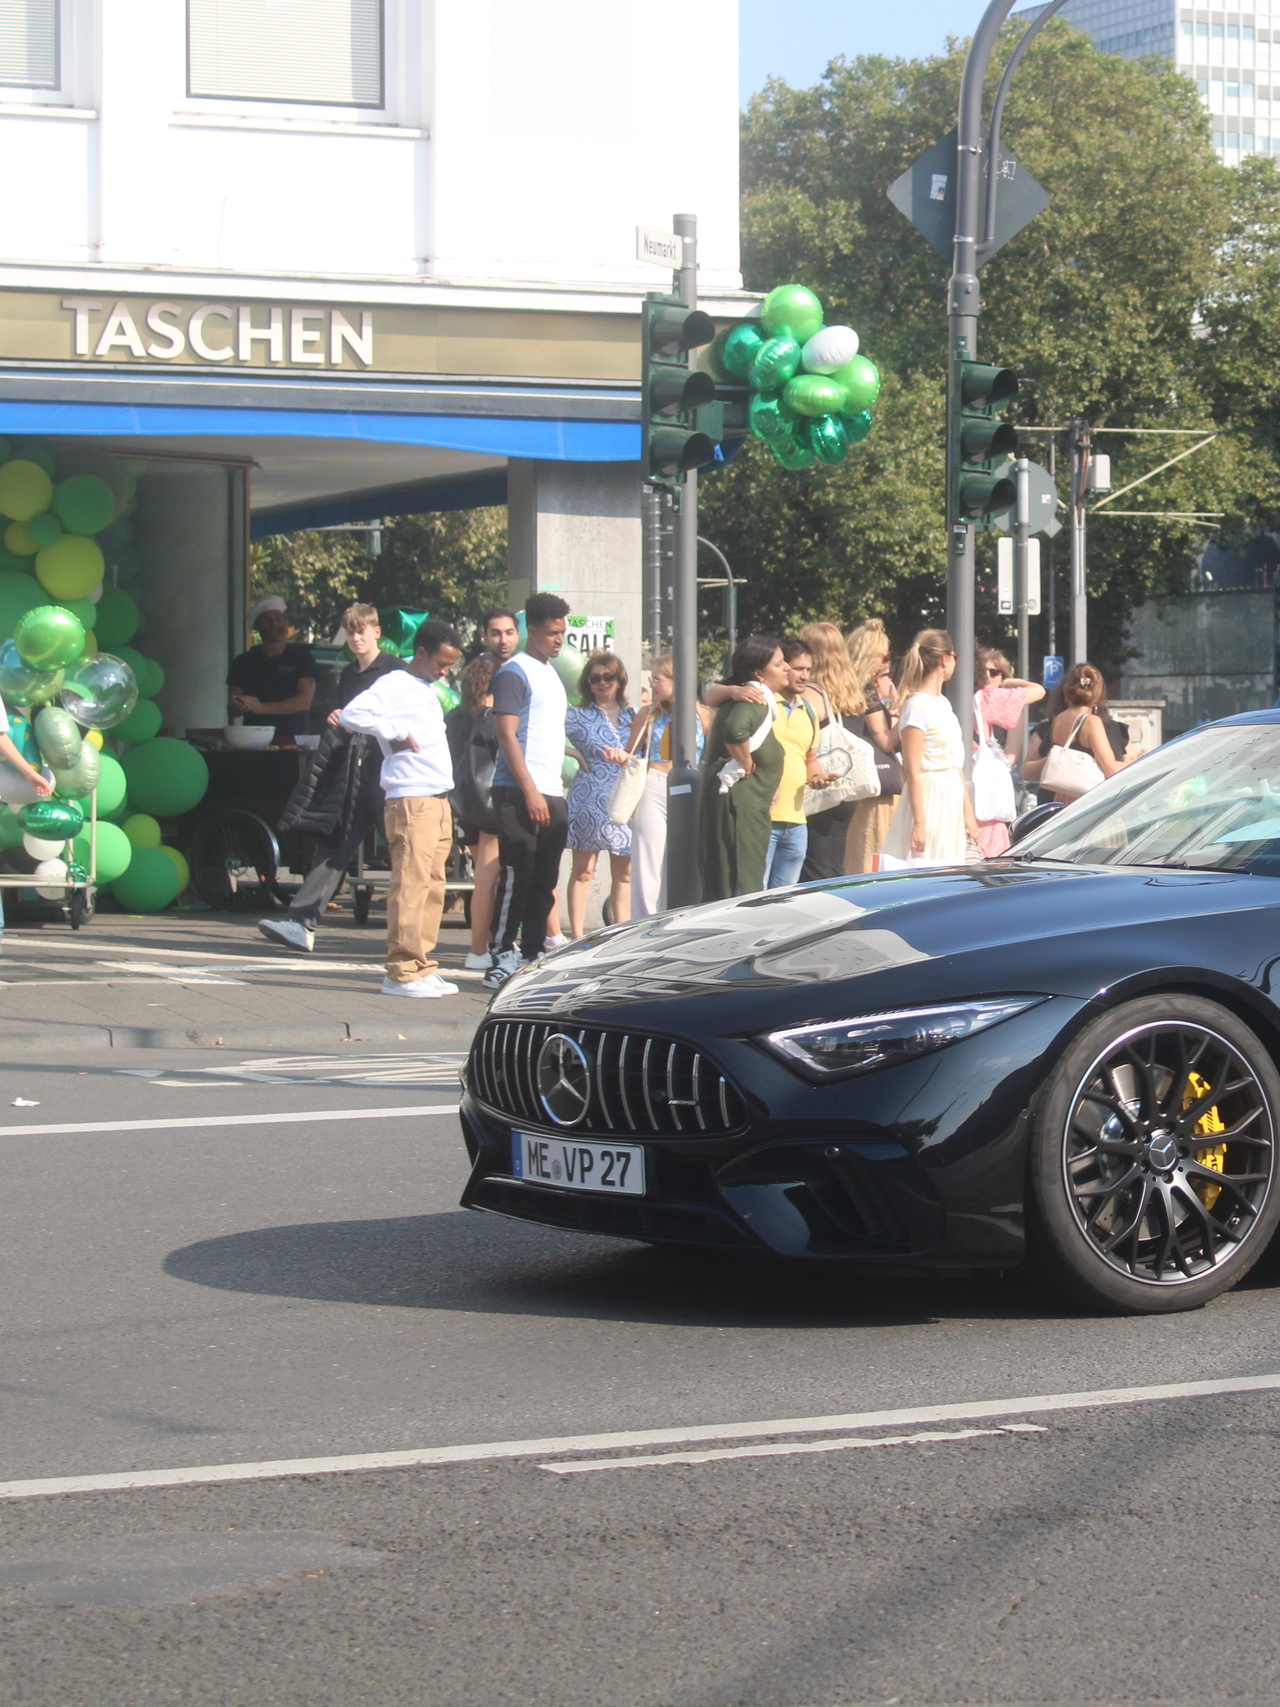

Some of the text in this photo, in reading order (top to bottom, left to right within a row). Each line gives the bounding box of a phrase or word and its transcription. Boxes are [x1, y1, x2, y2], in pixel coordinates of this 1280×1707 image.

[643, 233, 677, 260] Neumarkt
[62, 298, 373, 365] TASCHEN
[567, 619, 612, 629] TASCHEN
[527, 1140, 631, 1187] ME VP 27
